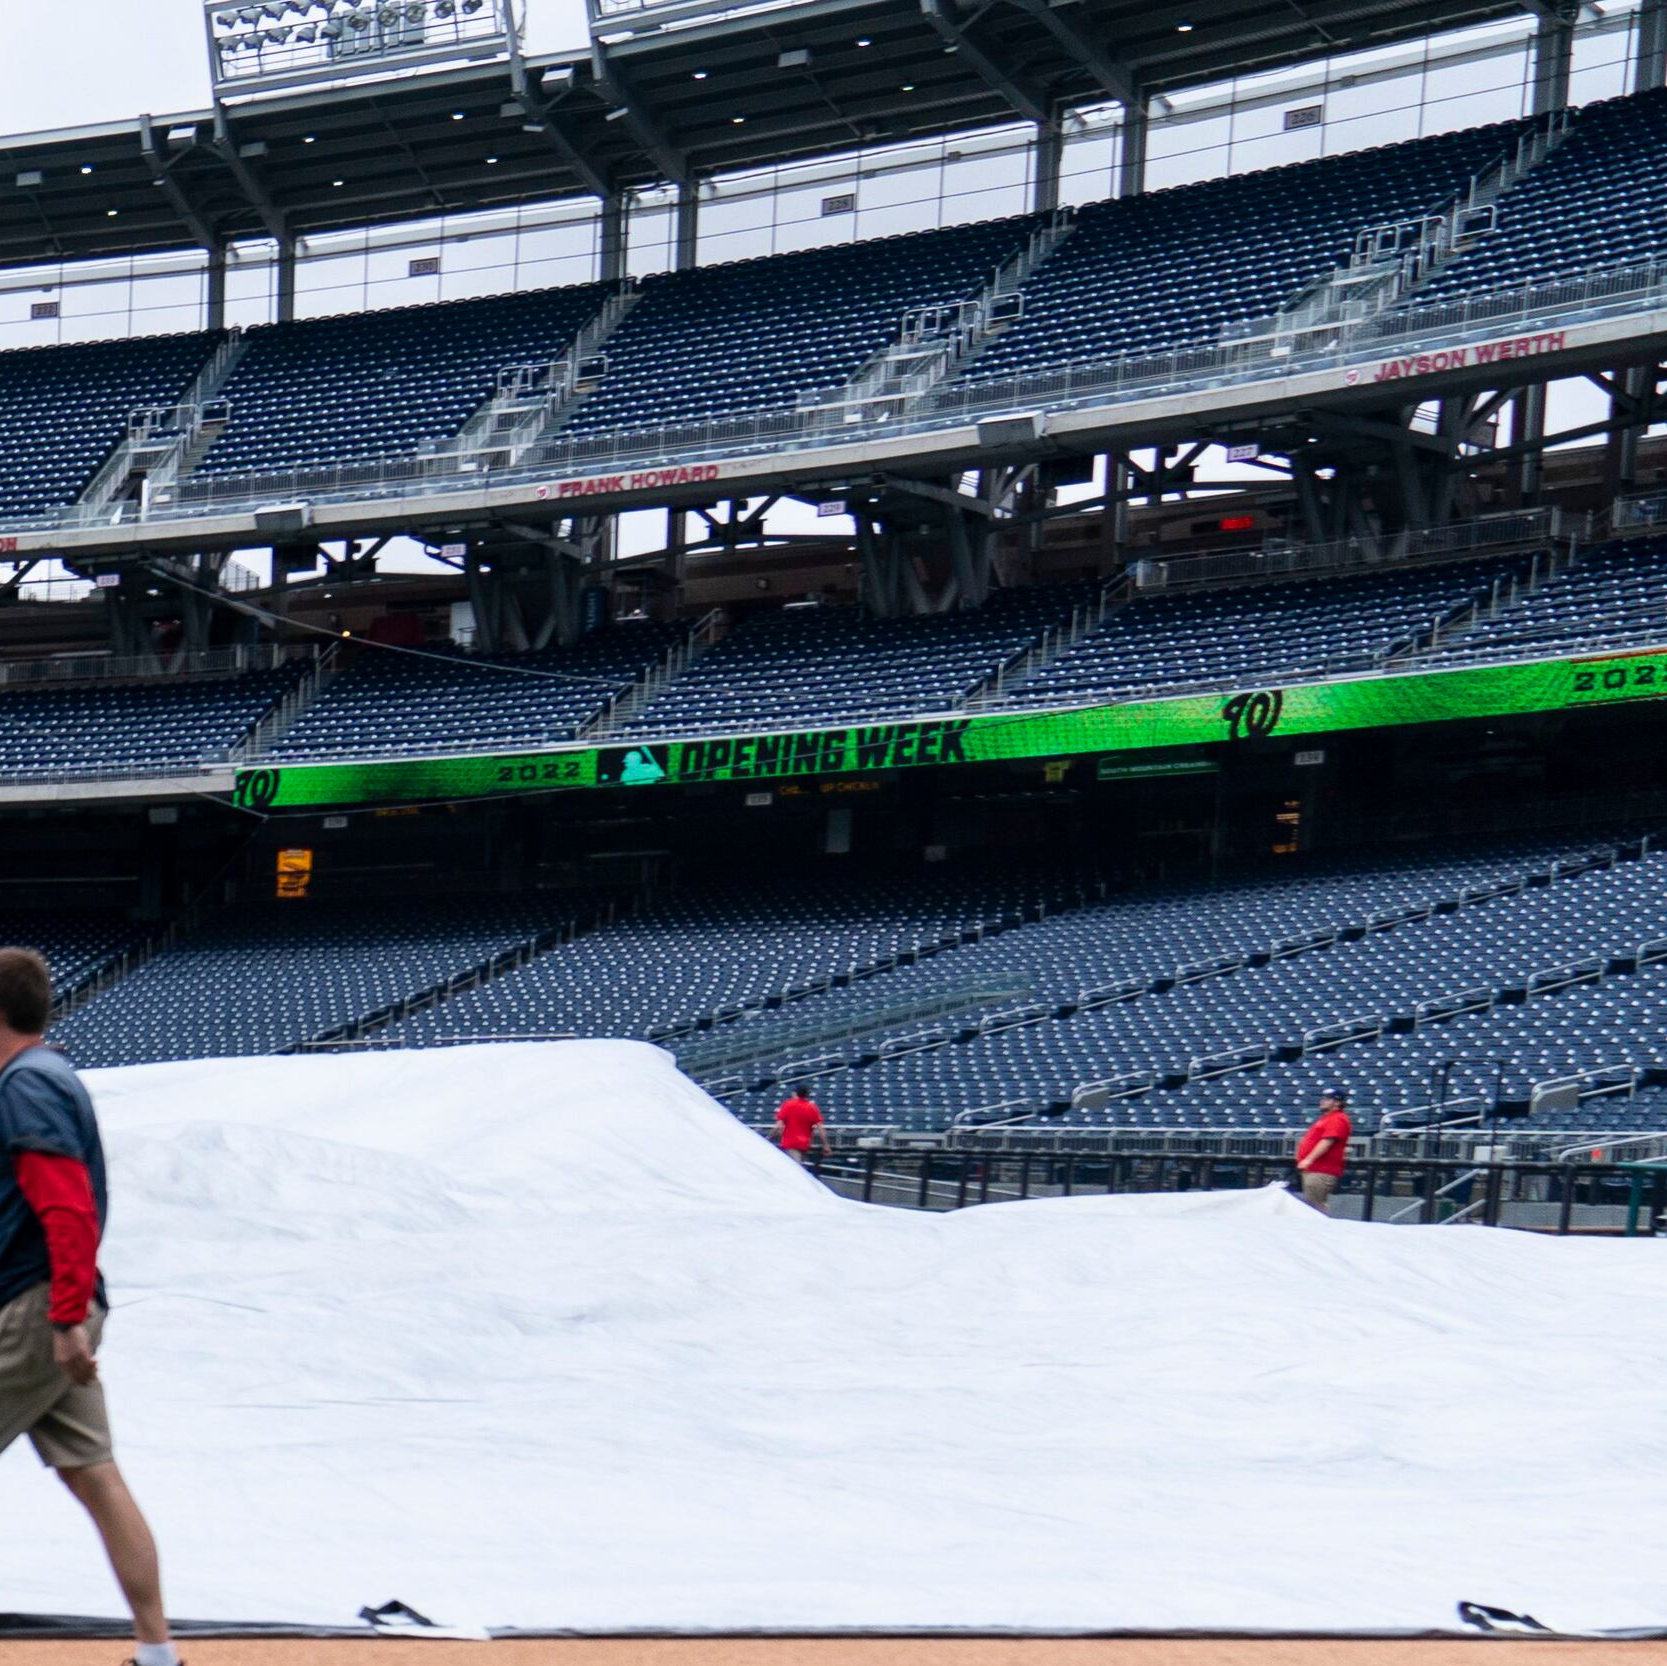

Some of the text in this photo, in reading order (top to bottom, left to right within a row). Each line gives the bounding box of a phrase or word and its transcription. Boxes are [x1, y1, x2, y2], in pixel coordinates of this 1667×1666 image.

[1374, 331, 1566, 383] JAYSON WERTH
[559, 464, 720, 497] FRANK HOWARD
[1574, 665, 1667, 692] 202
[679, 719, 965, 782] OPENING WEEK
[497, 761, 580, 782] 2022
